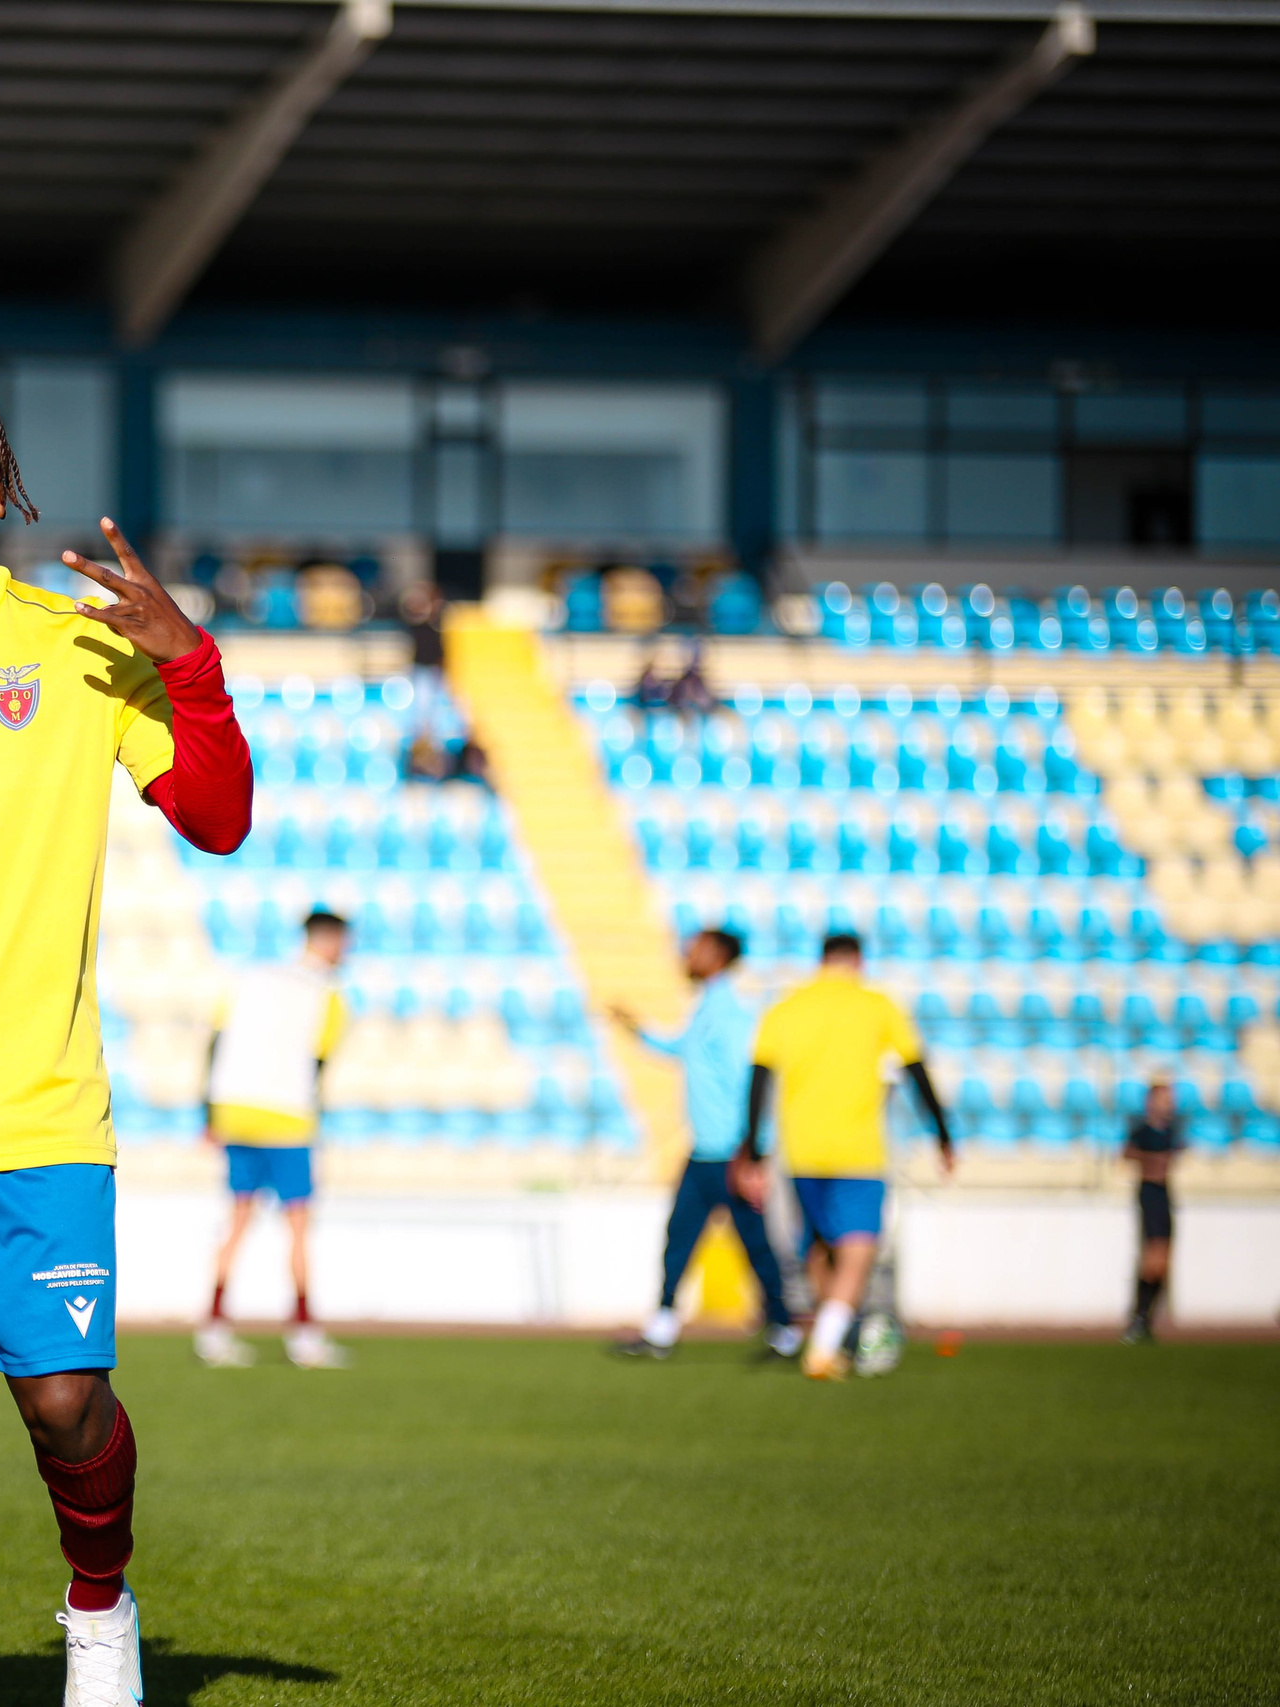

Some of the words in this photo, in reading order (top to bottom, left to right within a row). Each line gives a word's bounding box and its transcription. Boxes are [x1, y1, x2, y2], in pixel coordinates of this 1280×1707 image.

[11, 712, 21, 721] M
[32, 1269, 81, 1281] MOSCAVIDE
[86, 1268, 110, 1277] PORTELA
[46, 1281, 69, 1289] JUNTOS
